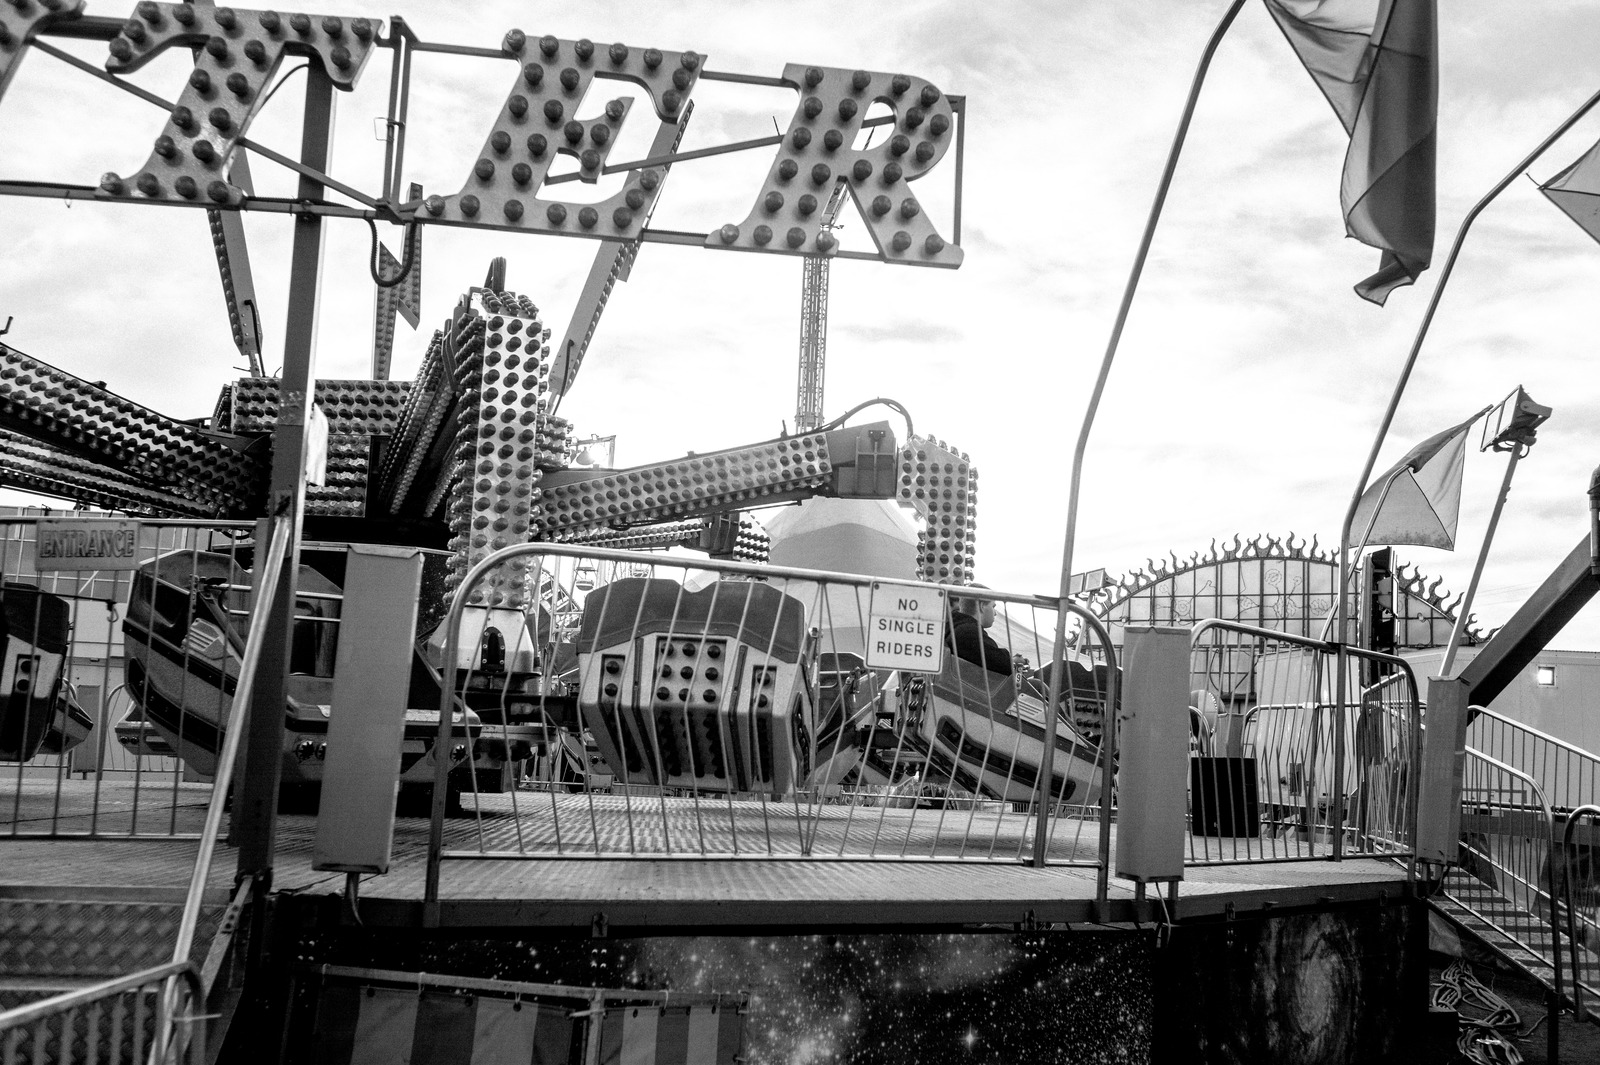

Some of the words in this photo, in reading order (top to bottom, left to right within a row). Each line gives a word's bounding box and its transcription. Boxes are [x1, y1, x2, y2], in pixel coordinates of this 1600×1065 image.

[0, 0, 964, 270] TER
[40, 529, 135, 558] ENTRANCE
[898, 598, 918, 611] NO
[878, 618, 935, 636] SINGLE
[876, 641, 933, 658] RIDERS
